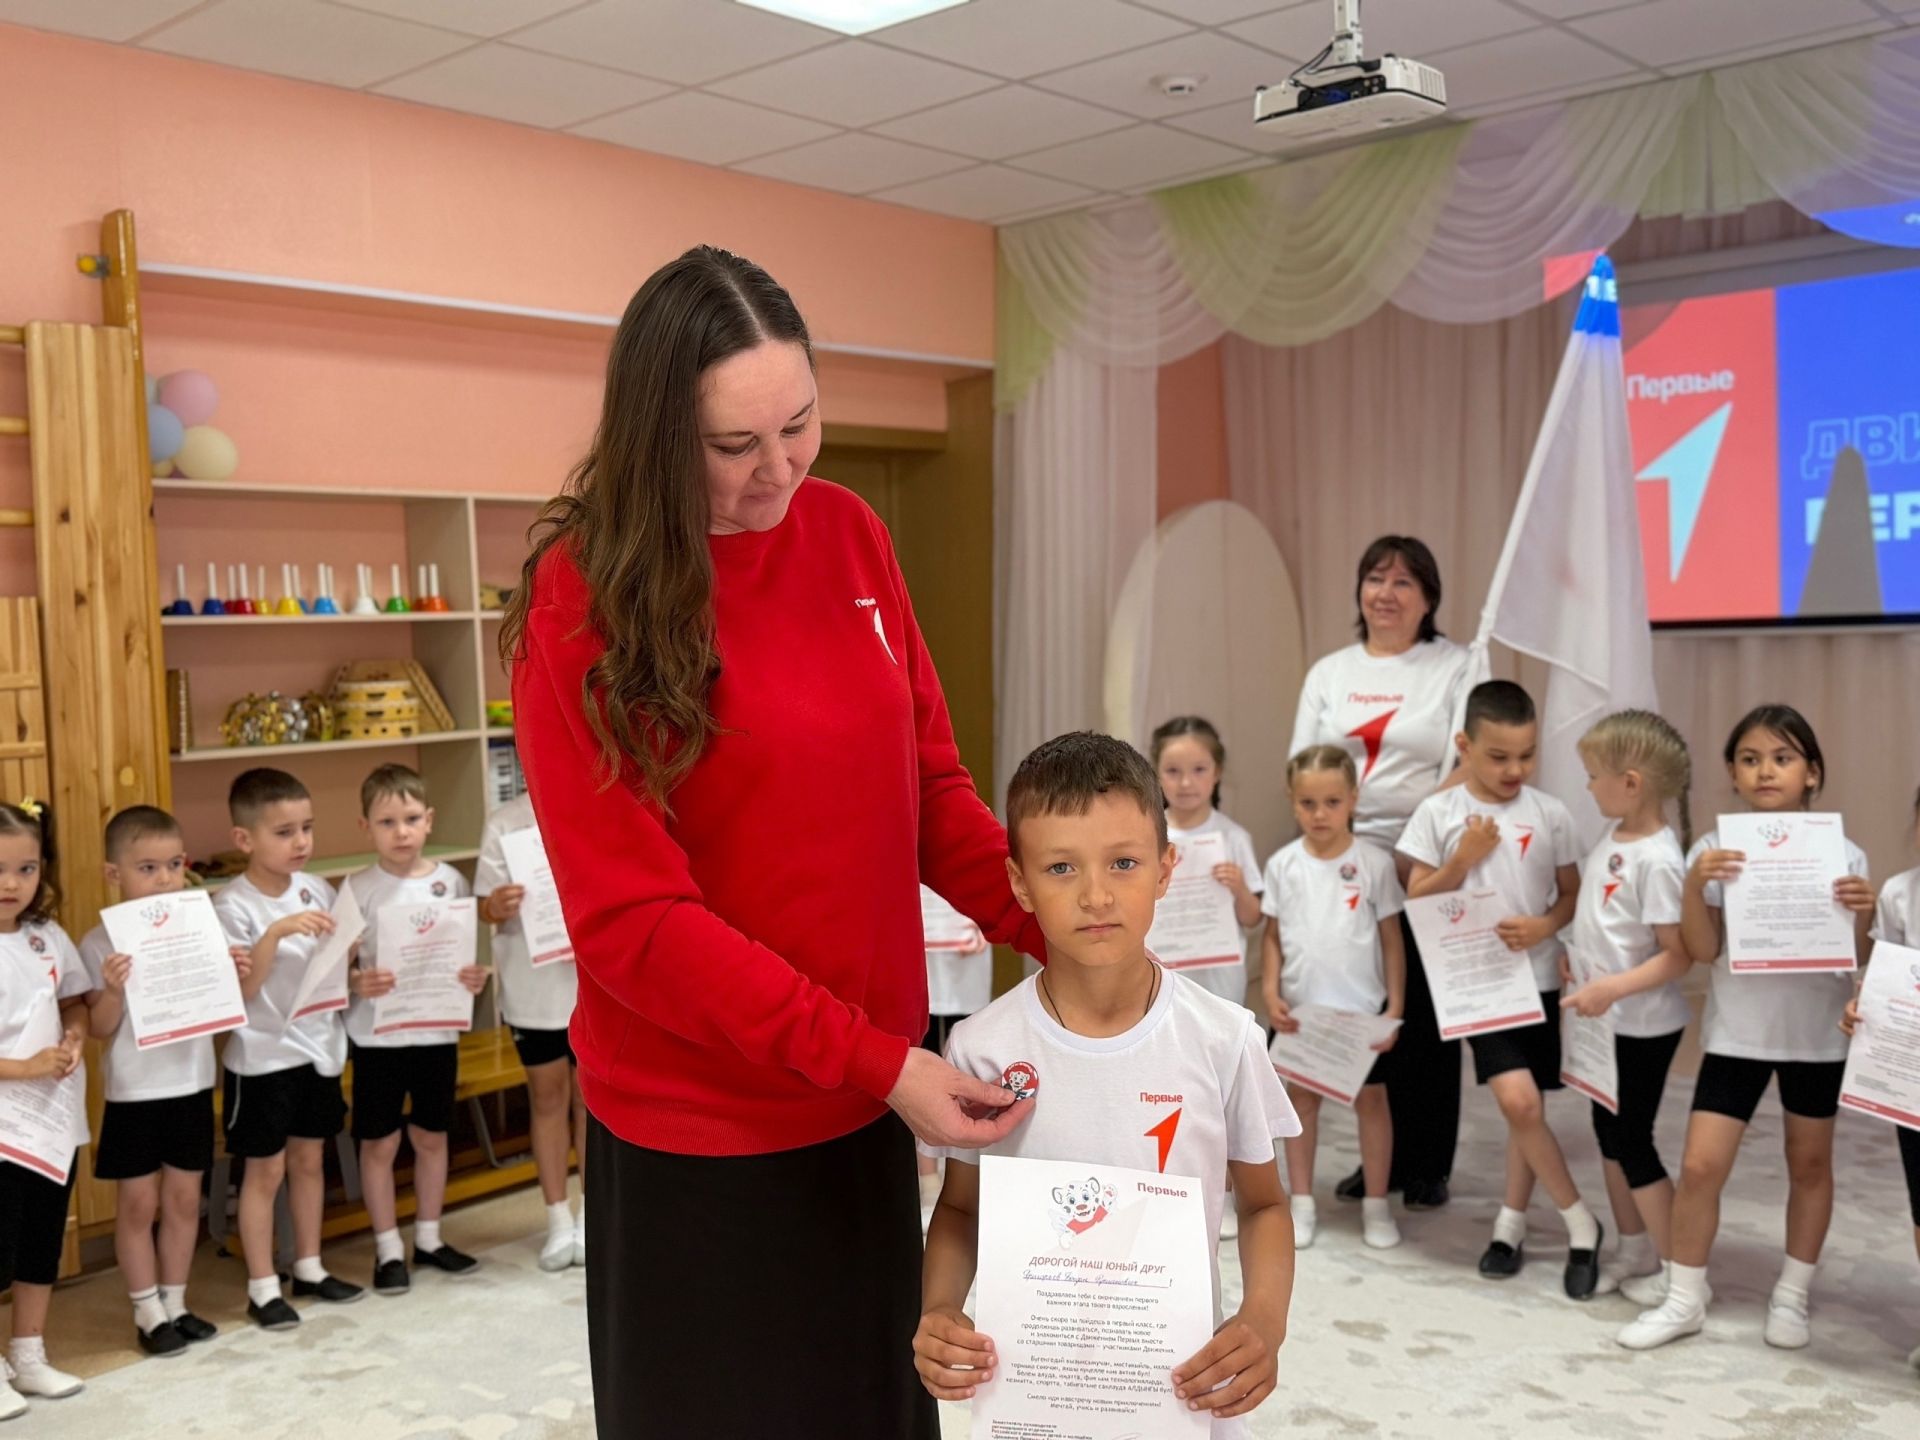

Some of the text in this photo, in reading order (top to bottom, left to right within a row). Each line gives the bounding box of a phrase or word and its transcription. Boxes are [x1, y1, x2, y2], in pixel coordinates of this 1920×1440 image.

[1626, 370, 1735, 403] Первые
[1140, 1092, 1183, 1106] Первые
[1137, 1182, 1188, 1198] Первые
[1029, 1256, 1166, 1275] ДОРОГОЙ НАШ ЮНЫЙ ДРУГ
